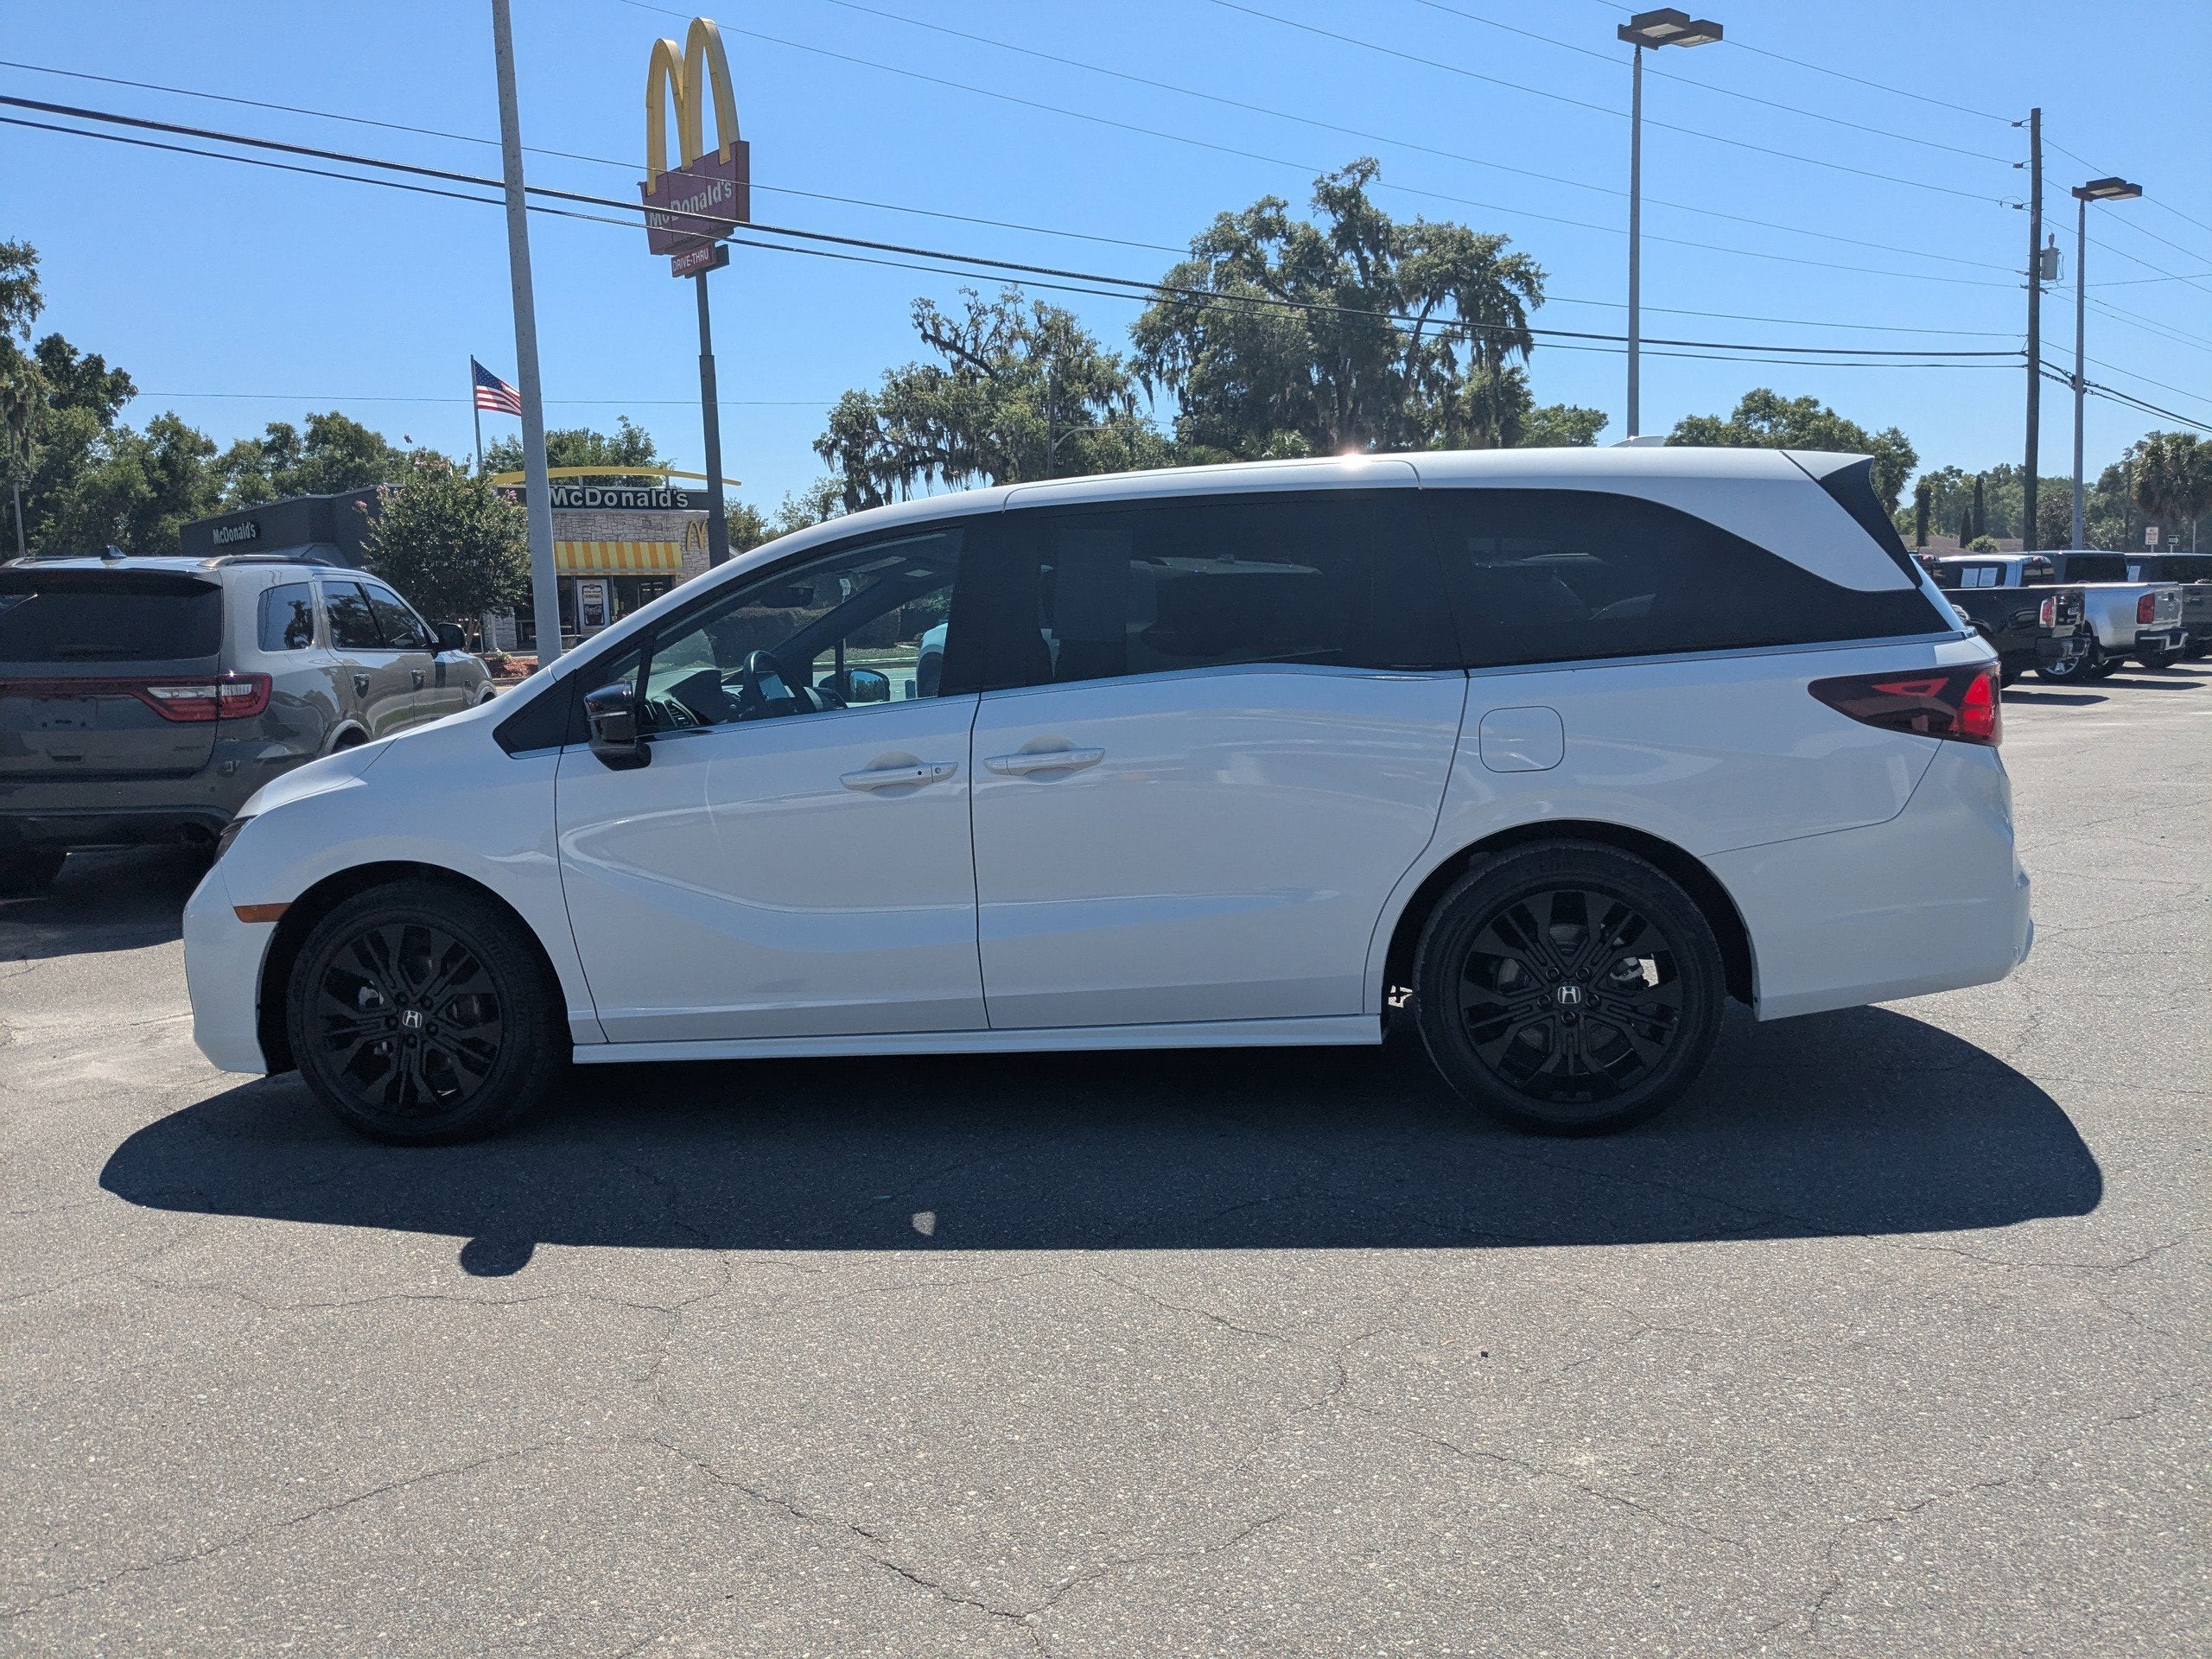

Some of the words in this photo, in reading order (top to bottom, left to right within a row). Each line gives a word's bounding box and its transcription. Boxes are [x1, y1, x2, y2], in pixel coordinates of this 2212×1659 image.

[650, 181, 732, 227] McDonald's
[673, 248, 709, 271] DRIVE-THRU
[550, 488, 689, 507] McDonald's
[213, 522, 256, 544] McDonald's
